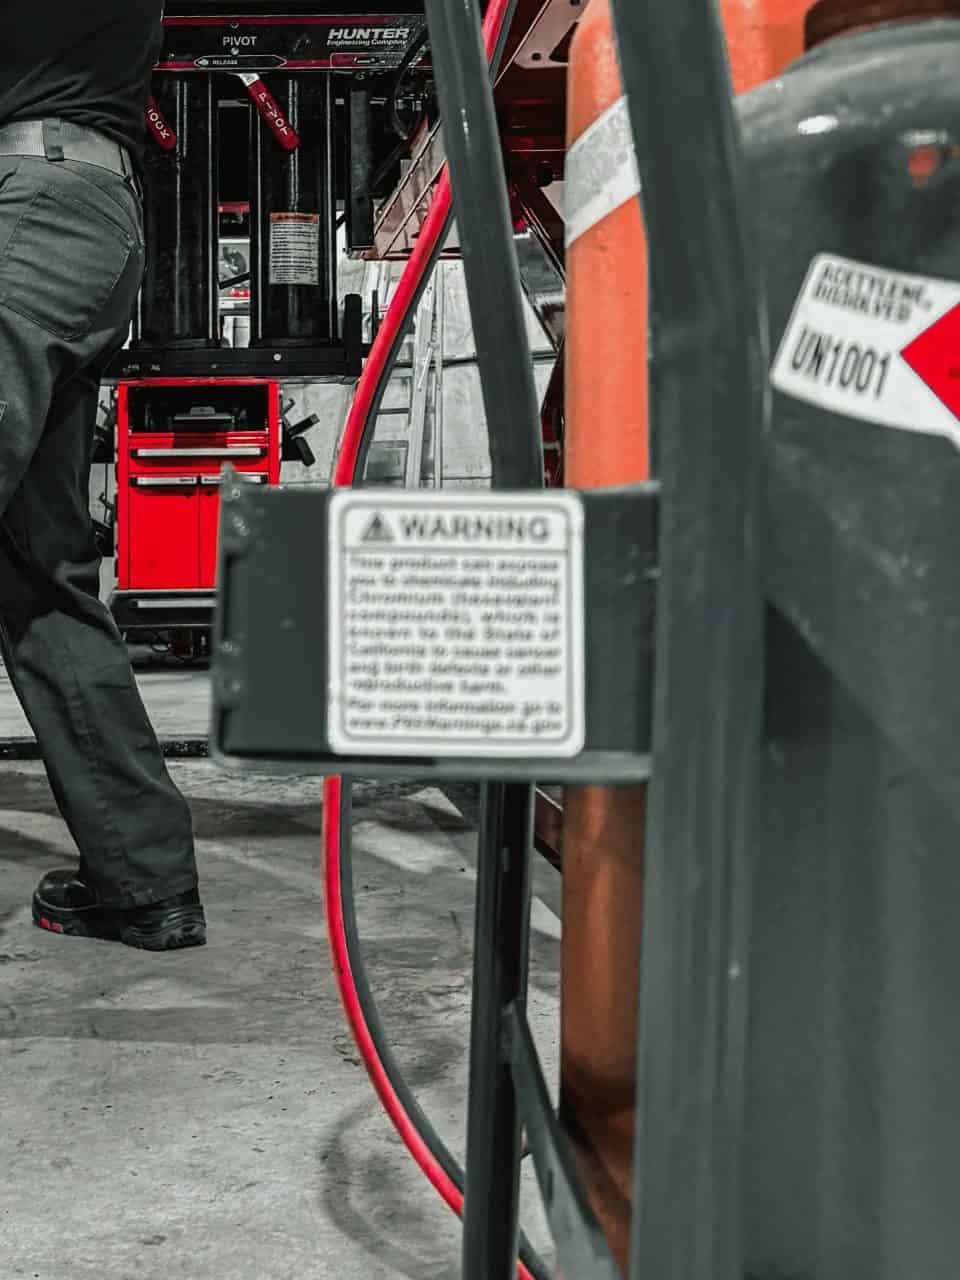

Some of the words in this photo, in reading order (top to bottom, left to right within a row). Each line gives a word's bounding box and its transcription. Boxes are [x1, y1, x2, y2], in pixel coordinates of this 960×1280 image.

[222, 36, 257, 47] PIVOT
[327, 28, 409, 40] HUNTER
[326, 39, 369, 47] Engineering
[371, 39, 408, 49] Company
[258, 92, 289, 136] PIVOT
[791, 322, 891, 401] UN1001
[399, 516, 549, 543] WARNING
